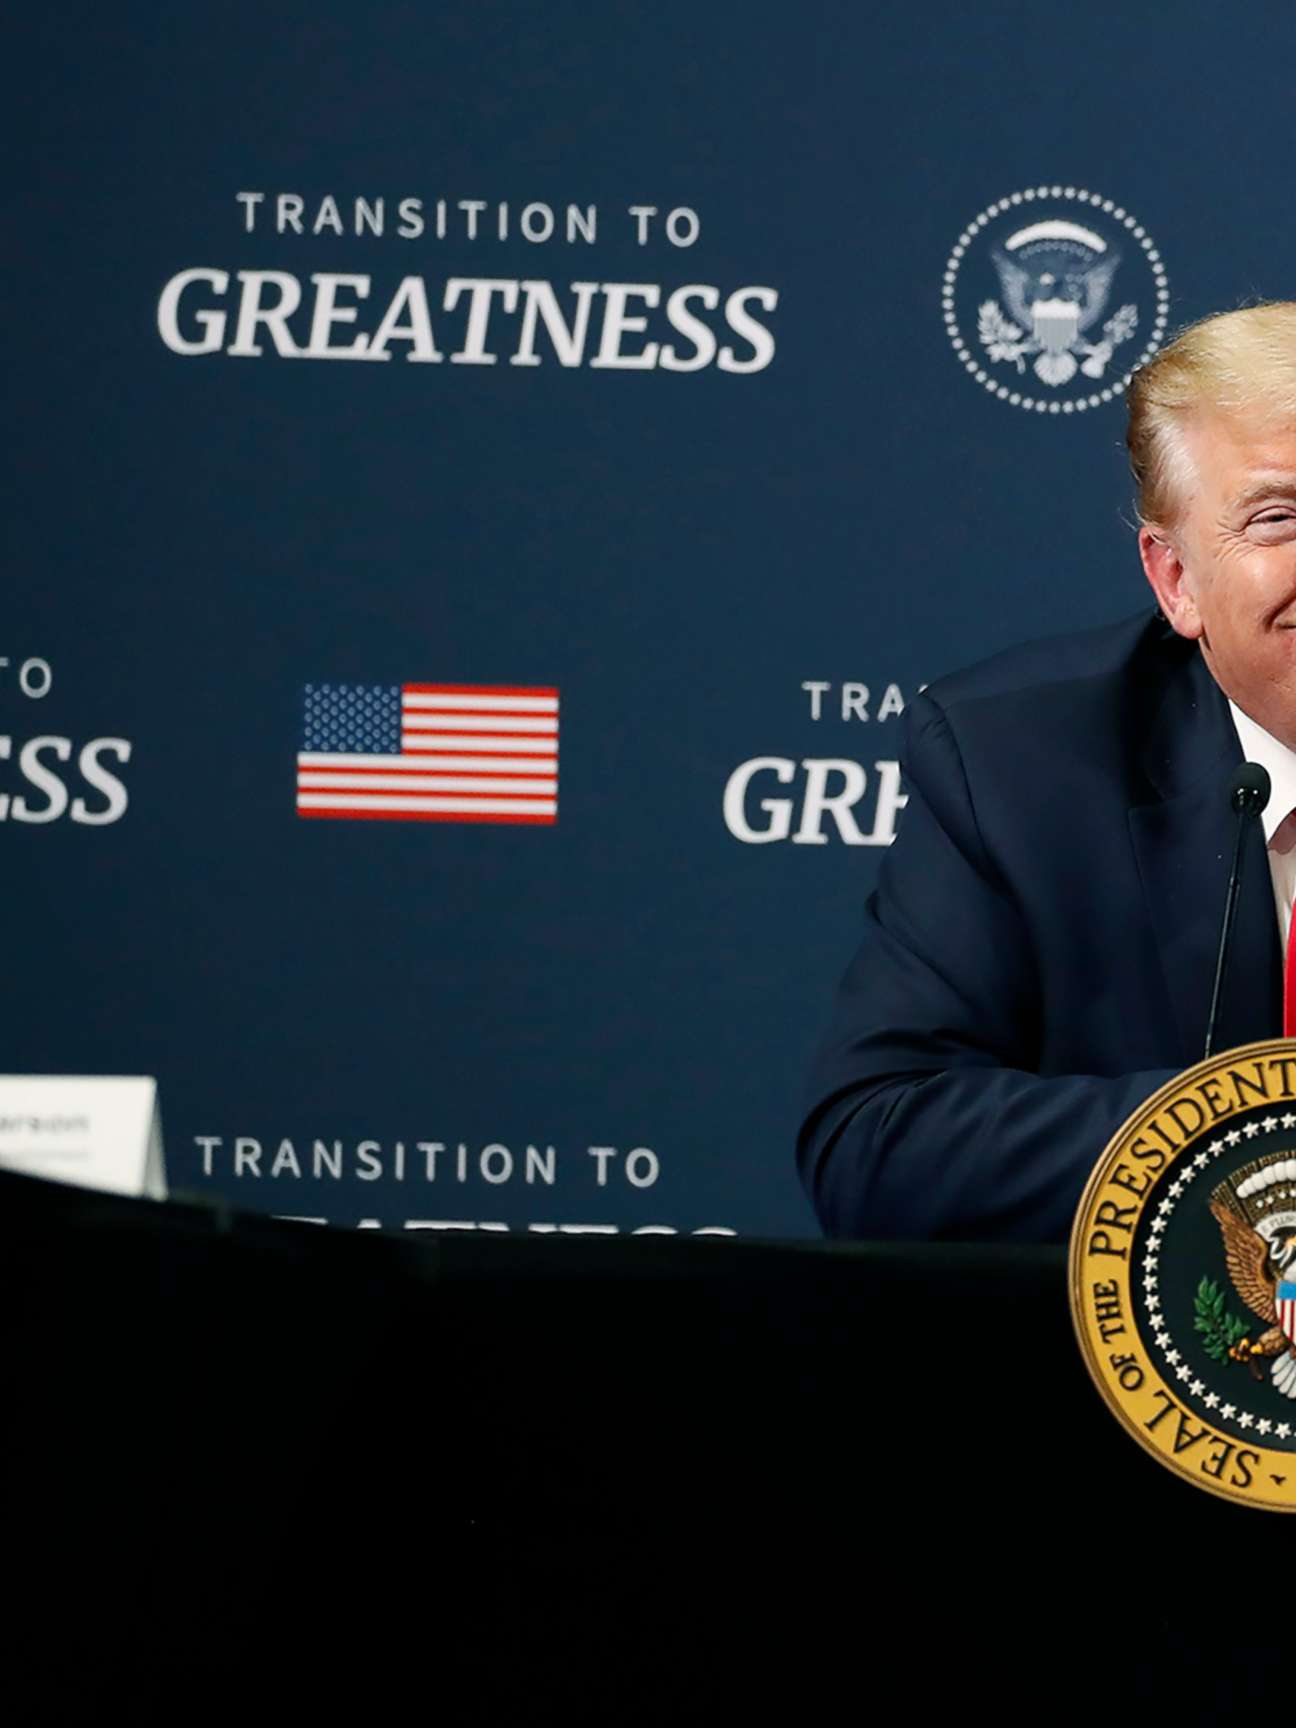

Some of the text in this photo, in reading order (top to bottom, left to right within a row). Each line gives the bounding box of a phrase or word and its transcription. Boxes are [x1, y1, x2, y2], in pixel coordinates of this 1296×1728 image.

[236, 192, 700, 248] TRANSITION TO
[157, 267, 779, 374] GREATNESS
[801, 681, 928, 723] TRA
[195, 1135, 660, 1188] TRANSITION TO
[1092, 1278, 1126, 1344] THE
[1109, 1352, 1145, 1392] OF
[1143, 1389, 1261, 1489] SEAL
